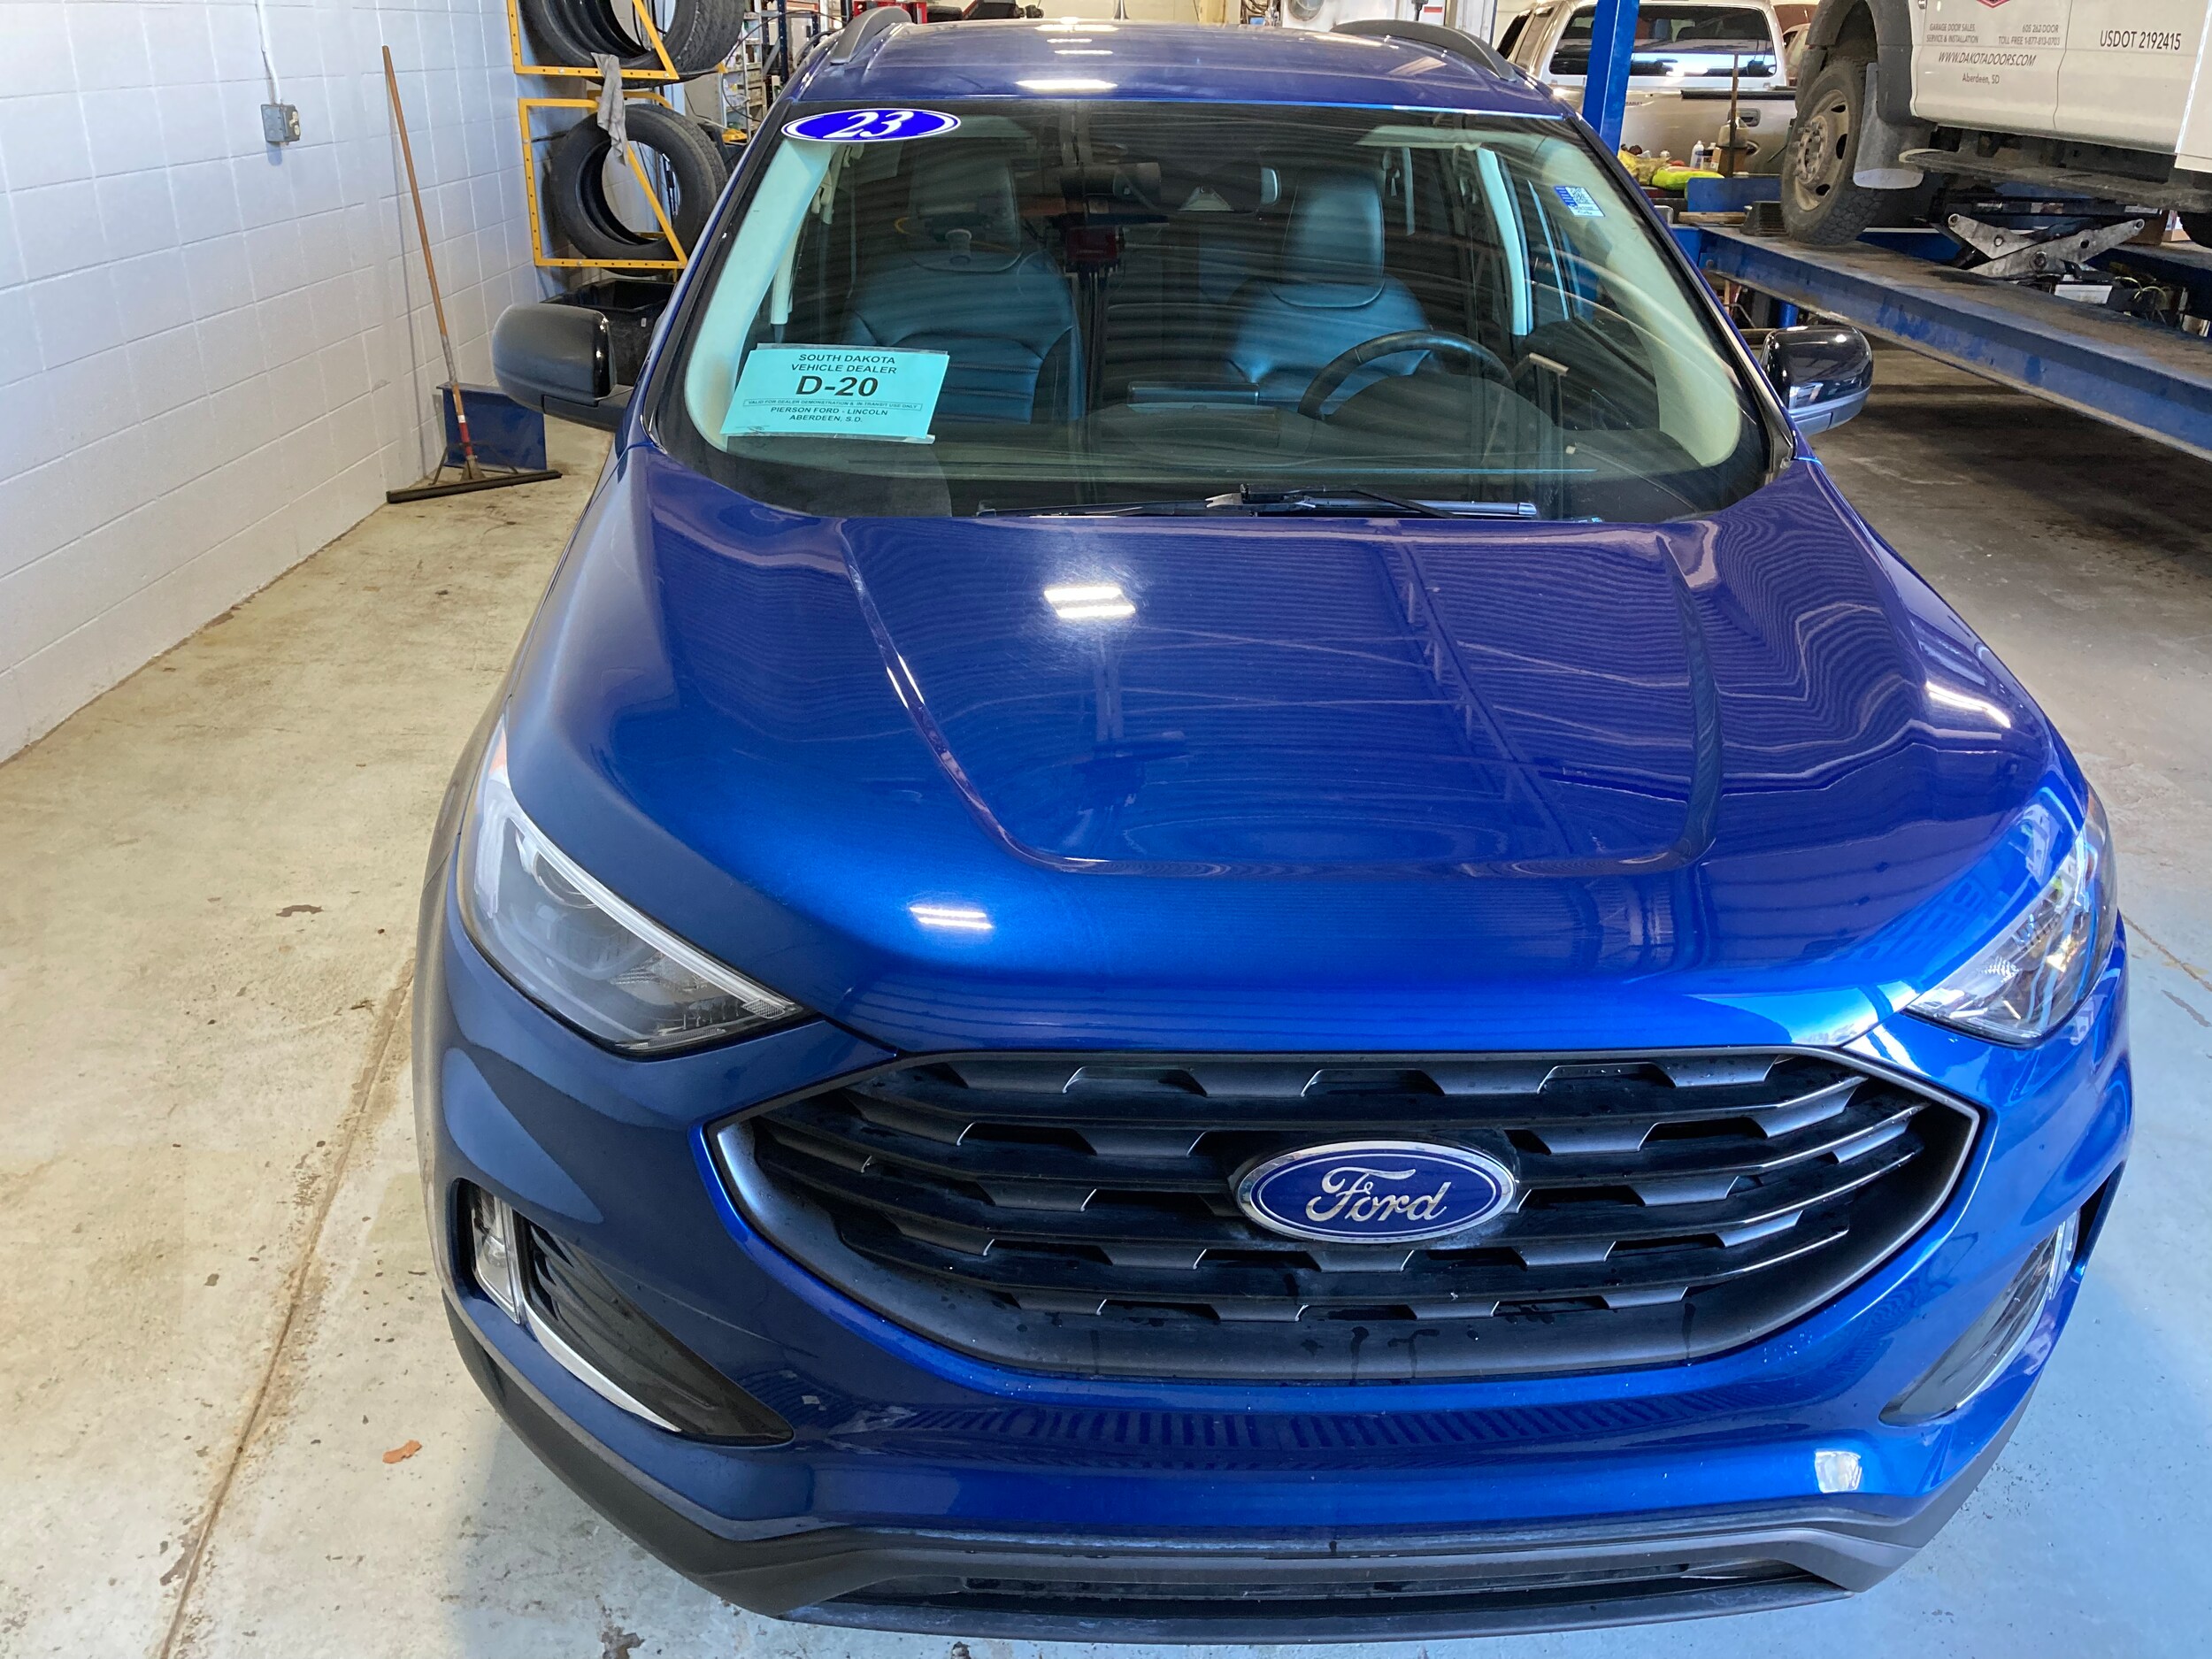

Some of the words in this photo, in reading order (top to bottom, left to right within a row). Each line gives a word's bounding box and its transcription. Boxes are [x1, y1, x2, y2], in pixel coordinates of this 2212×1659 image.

[2011, 36, 2024, 45] FREE
[2100, 30, 2138, 48] USDOT
[2139, 31, 2182, 50] 2192415
[1938, 51, 2037, 66] WWW.DAKOTADOORS.COM
[1962, 73, 1990, 84] Aberdeen,
[1992, 74, 2001, 84] SD
[823, 111, 915, 139] 23
[844, 355, 895, 365] DAKOTA
[846, 365, 897, 374] DEALER
[795, 375, 879, 397] D-20
[1305, 1166, 1452, 1222] Ford
